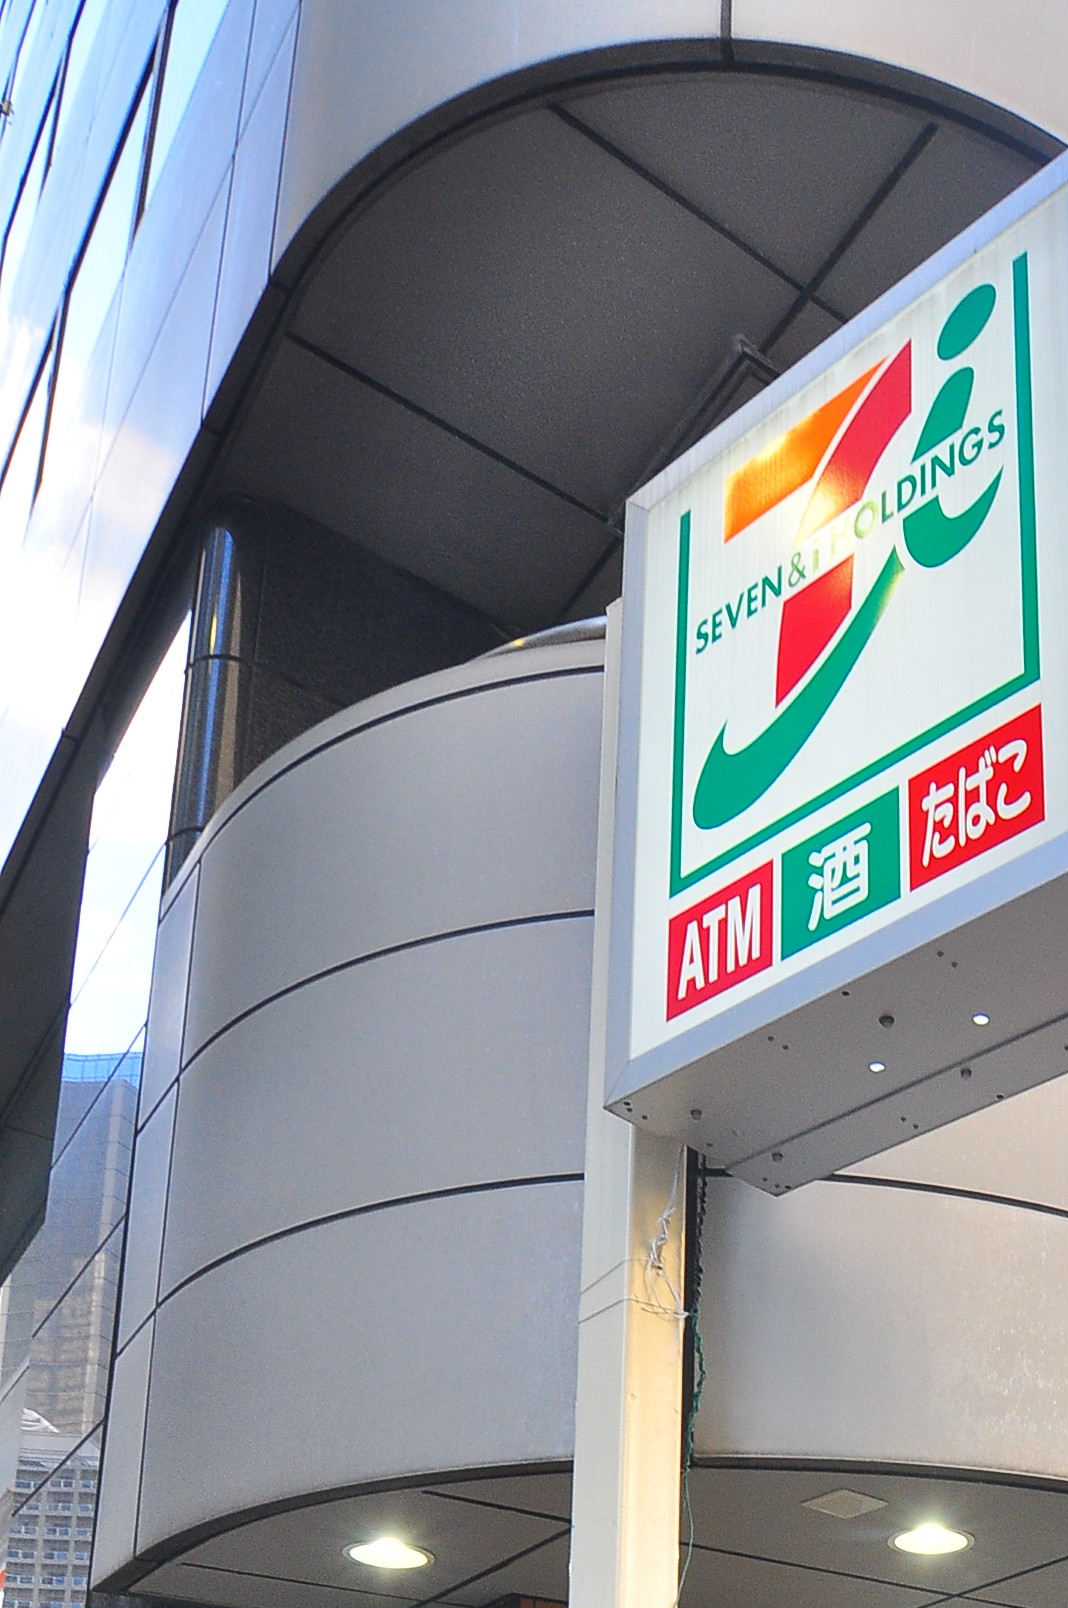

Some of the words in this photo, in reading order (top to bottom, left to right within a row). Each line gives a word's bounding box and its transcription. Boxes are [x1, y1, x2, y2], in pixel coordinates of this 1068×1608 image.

[921, 738, 1032, 868] たばこ
[807, 821, 873, 932] 酒
[677, 882, 762, 1001] ATM
